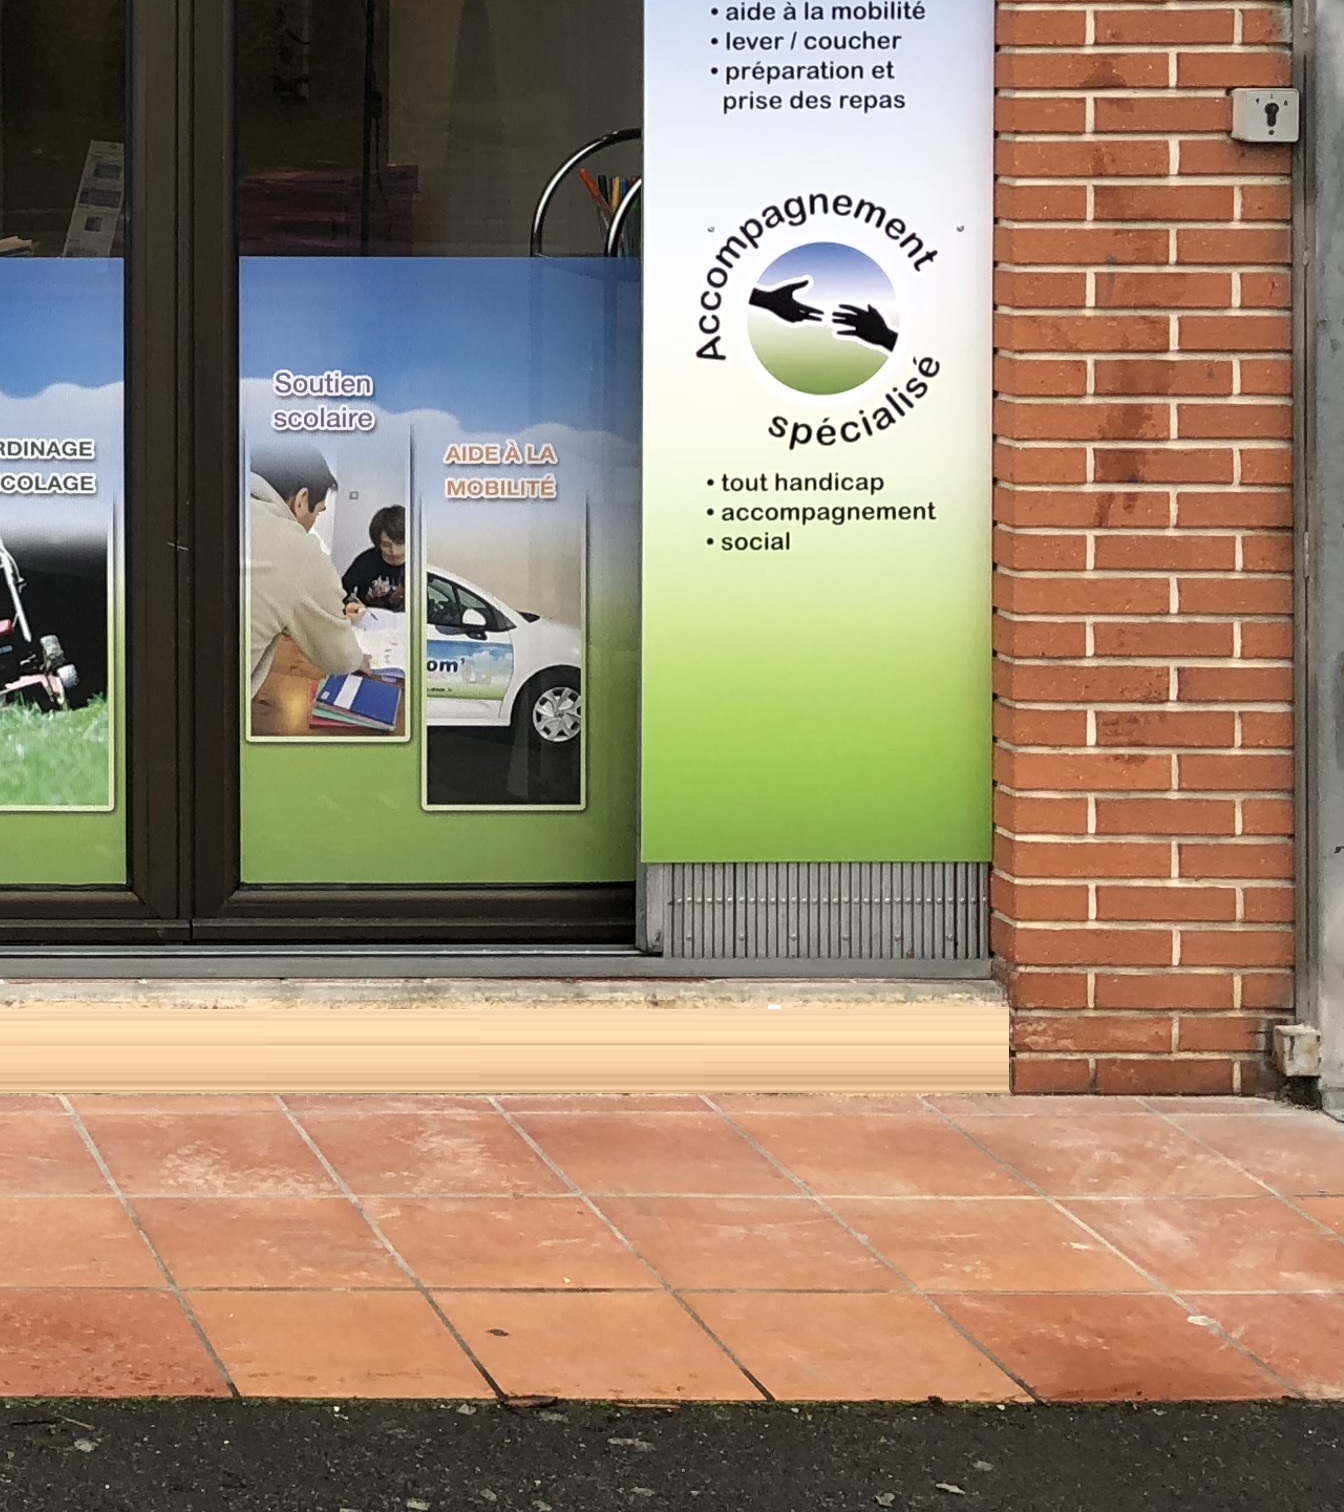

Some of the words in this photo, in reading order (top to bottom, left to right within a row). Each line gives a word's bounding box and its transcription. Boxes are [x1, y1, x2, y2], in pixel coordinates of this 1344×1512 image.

[725, 2, 776, 21] aide
[783, 2, 797, 21] à
[804, 2, 824, 21] la
[831, 1, 926, 21] mobilité
[725, 31, 784, 50] lever
[790, 31, 798, 50] /
[804, 31, 902, 50] coucher
[725, 61, 864, 85] préparation
[872, 62, 895, 80] et
[723, 91, 783, 114] prise
[789, 91, 832, 110] des
[839, 94, 906, 114] repas
[696, 192, 939, 361] Accompagnement
[274, 371, 372, 395] Soutien
[768, 354, 941, 451] spécialisé
[273, 406, 374, 429] scolaire
[445, 445, 499, 462] AIDE
[503, 440, 521, 462] À
[526, 445, 556, 462] LA
[446, 476, 555, 496] MOBILITÉ
[721, 473, 768, 492] tout
[775, 472, 884, 495] handicap
[721, 501, 936, 525] accompagnement
[721, 532, 790, 551] social
